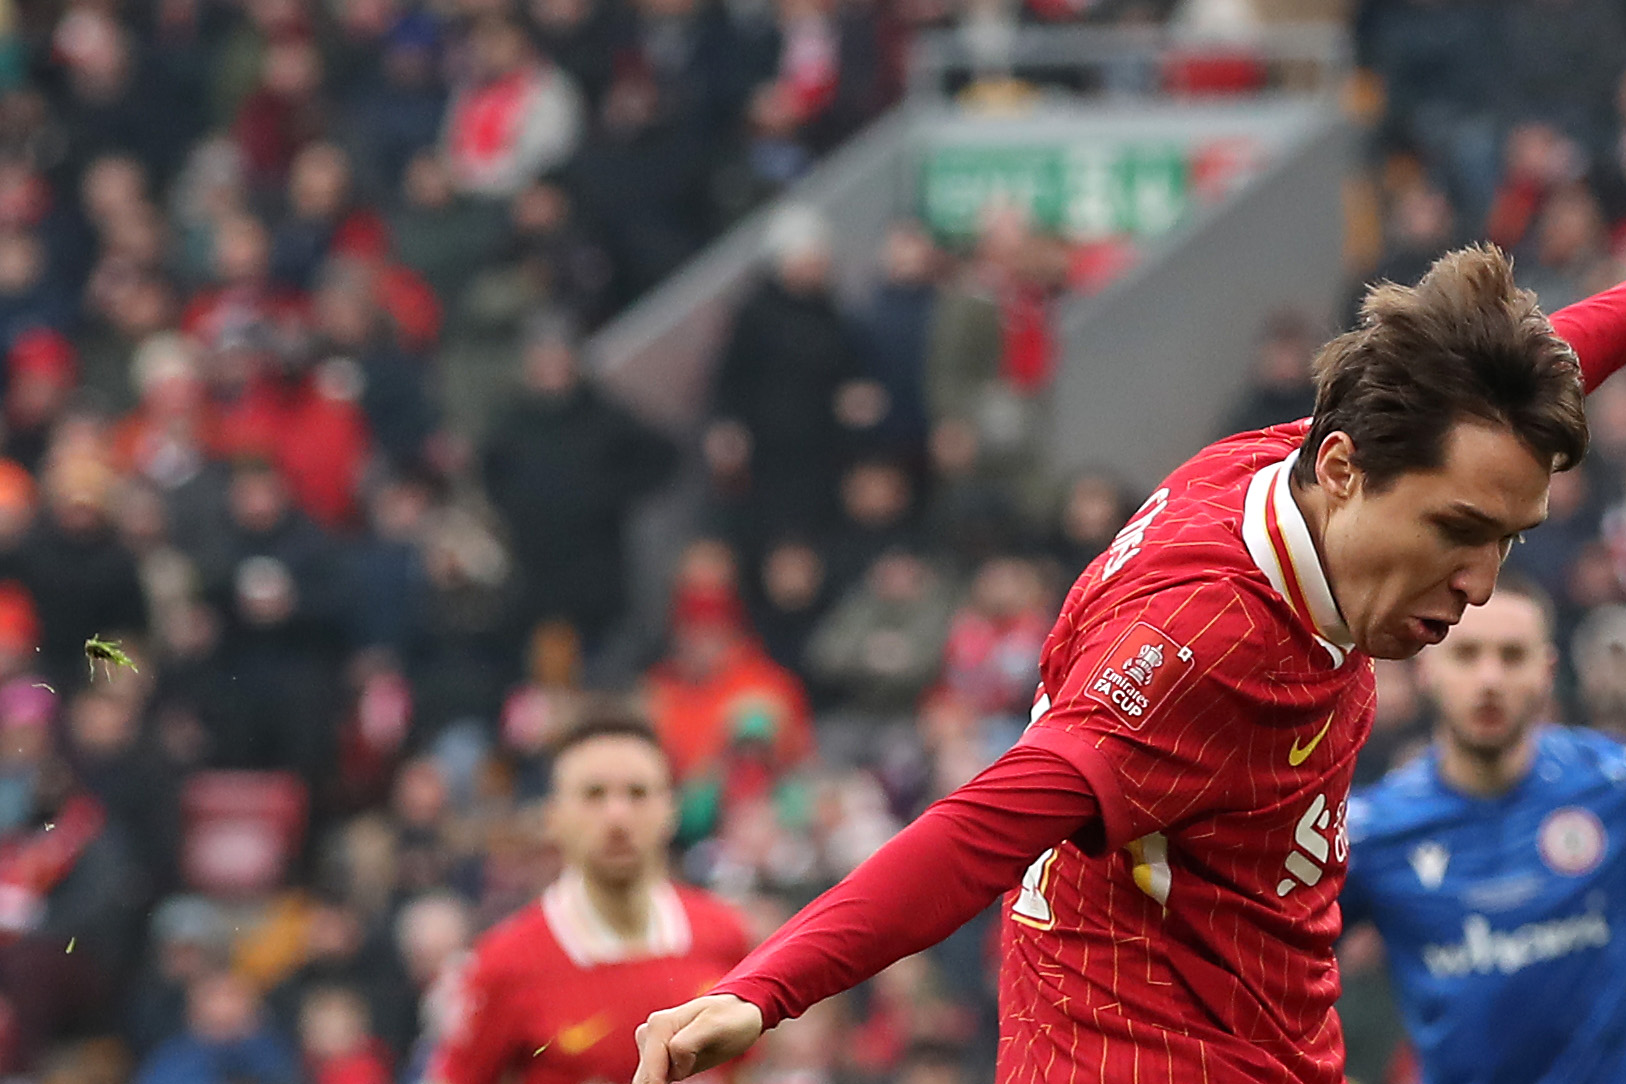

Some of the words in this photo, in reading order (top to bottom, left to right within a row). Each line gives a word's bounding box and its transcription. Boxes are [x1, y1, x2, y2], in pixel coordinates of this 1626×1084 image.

[1093, 678, 1112, 695] FA
[1111, 689, 1143, 717] CUP
[1102, 667, 1150, 708] Emirates
